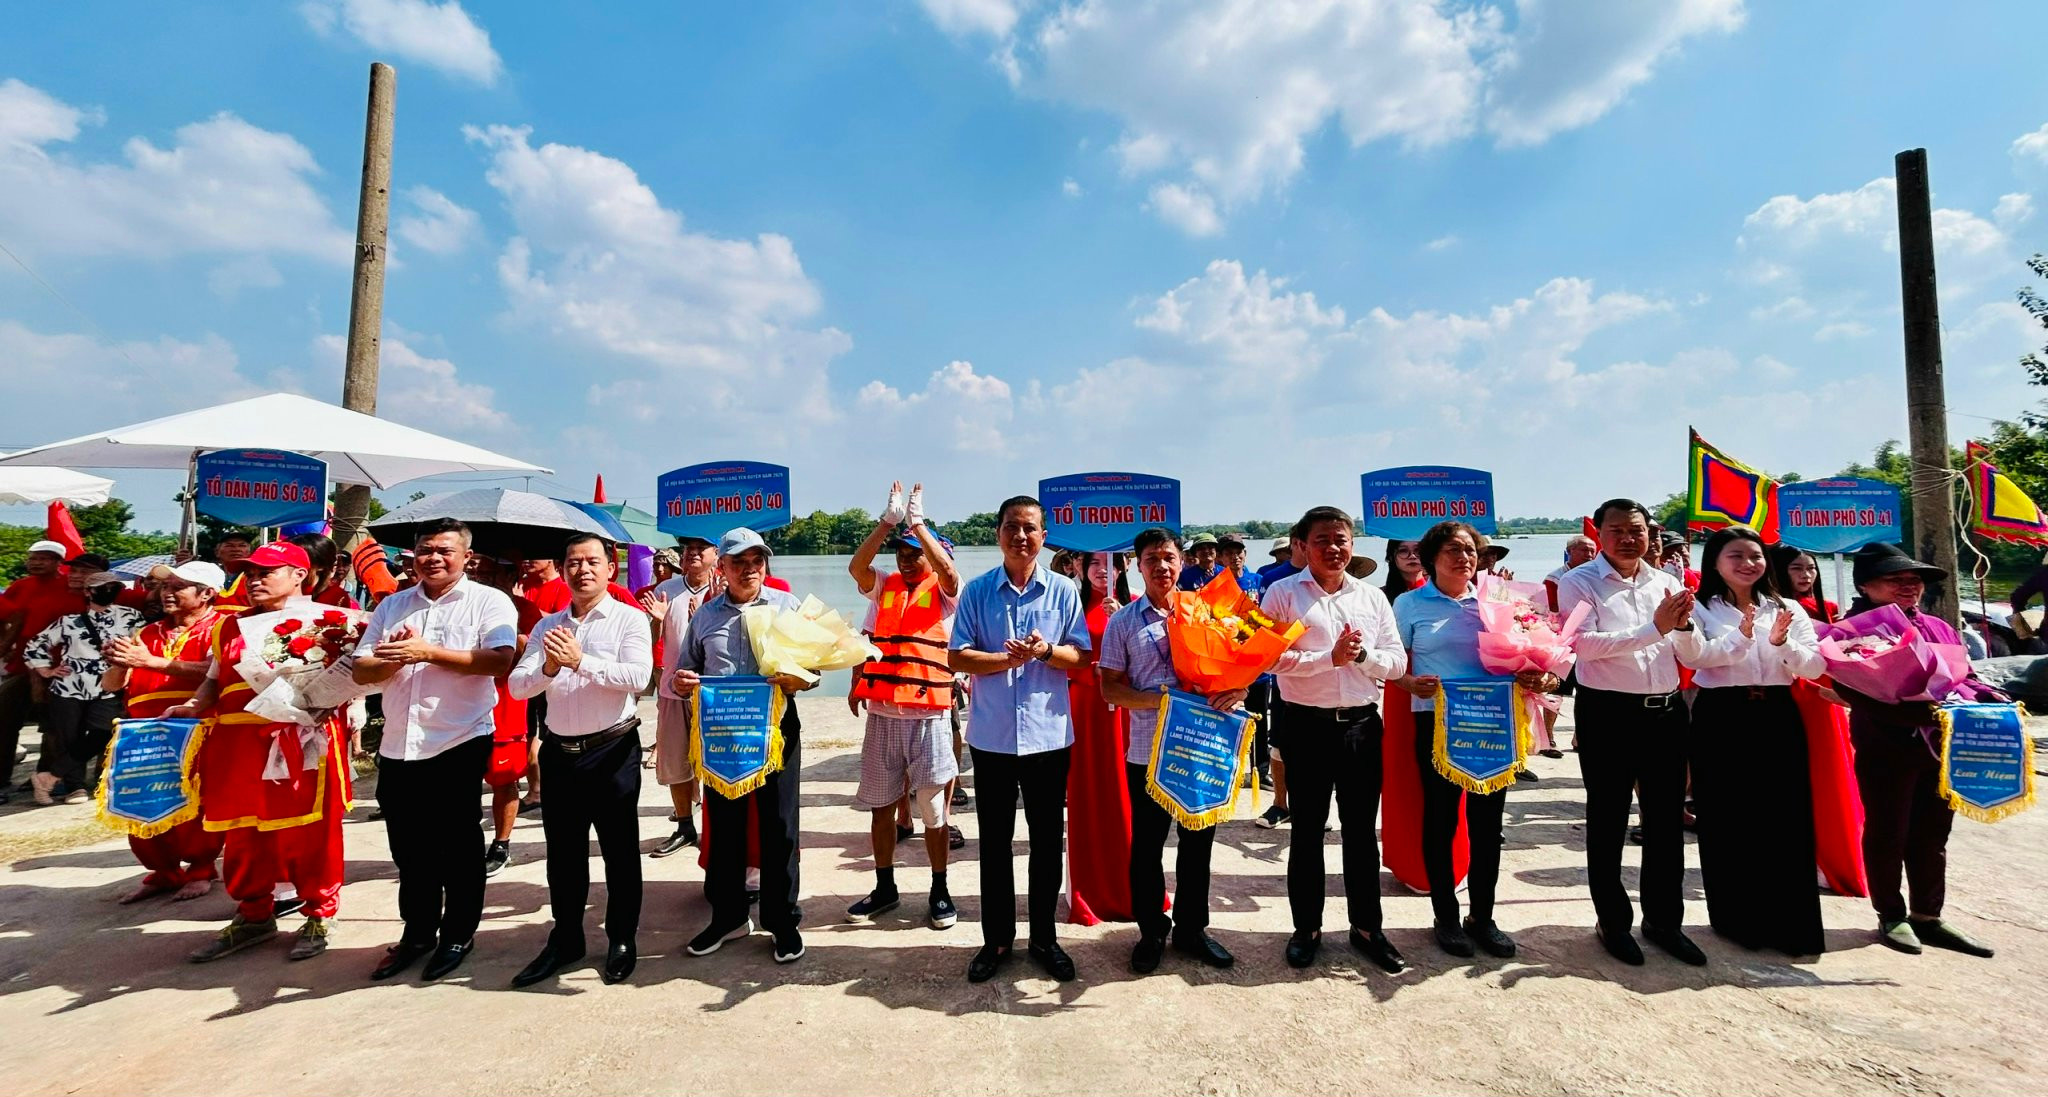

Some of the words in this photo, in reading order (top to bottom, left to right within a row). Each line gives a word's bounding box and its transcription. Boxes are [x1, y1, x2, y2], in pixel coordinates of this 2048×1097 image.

[206, 472, 222, 497] TỔ
[224, 477, 250, 499] DÂN
[301, 486, 317, 503] 34
[666, 493, 682, 518] TỔ
[686, 496, 712, 516] DÂN
[716, 489, 742, 514] PHỐ
[745, 487, 763, 512] SỐ
[767, 492, 783, 510] 40
[1052, 500, 1074, 525] TỔ
[1078, 505, 1135, 528] TRỌNG
[1139, 500, 1166, 523] TÀI
[1372, 494, 1388, 518] TỔ
[1391, 497, 1418, 518] DÂN
[1420, 495, 1447, 518] PHỐ
[1450, 493, 1467, 517] SỐ
[1470, 500, 1486, 517] 39
[1788, 503, 1803, 527] TỔ
[1833, 503, 1857, 527] PHỐ
[1859, 503, 1875, 527] SỐ
[1878, 509, 1893, 527] 41
